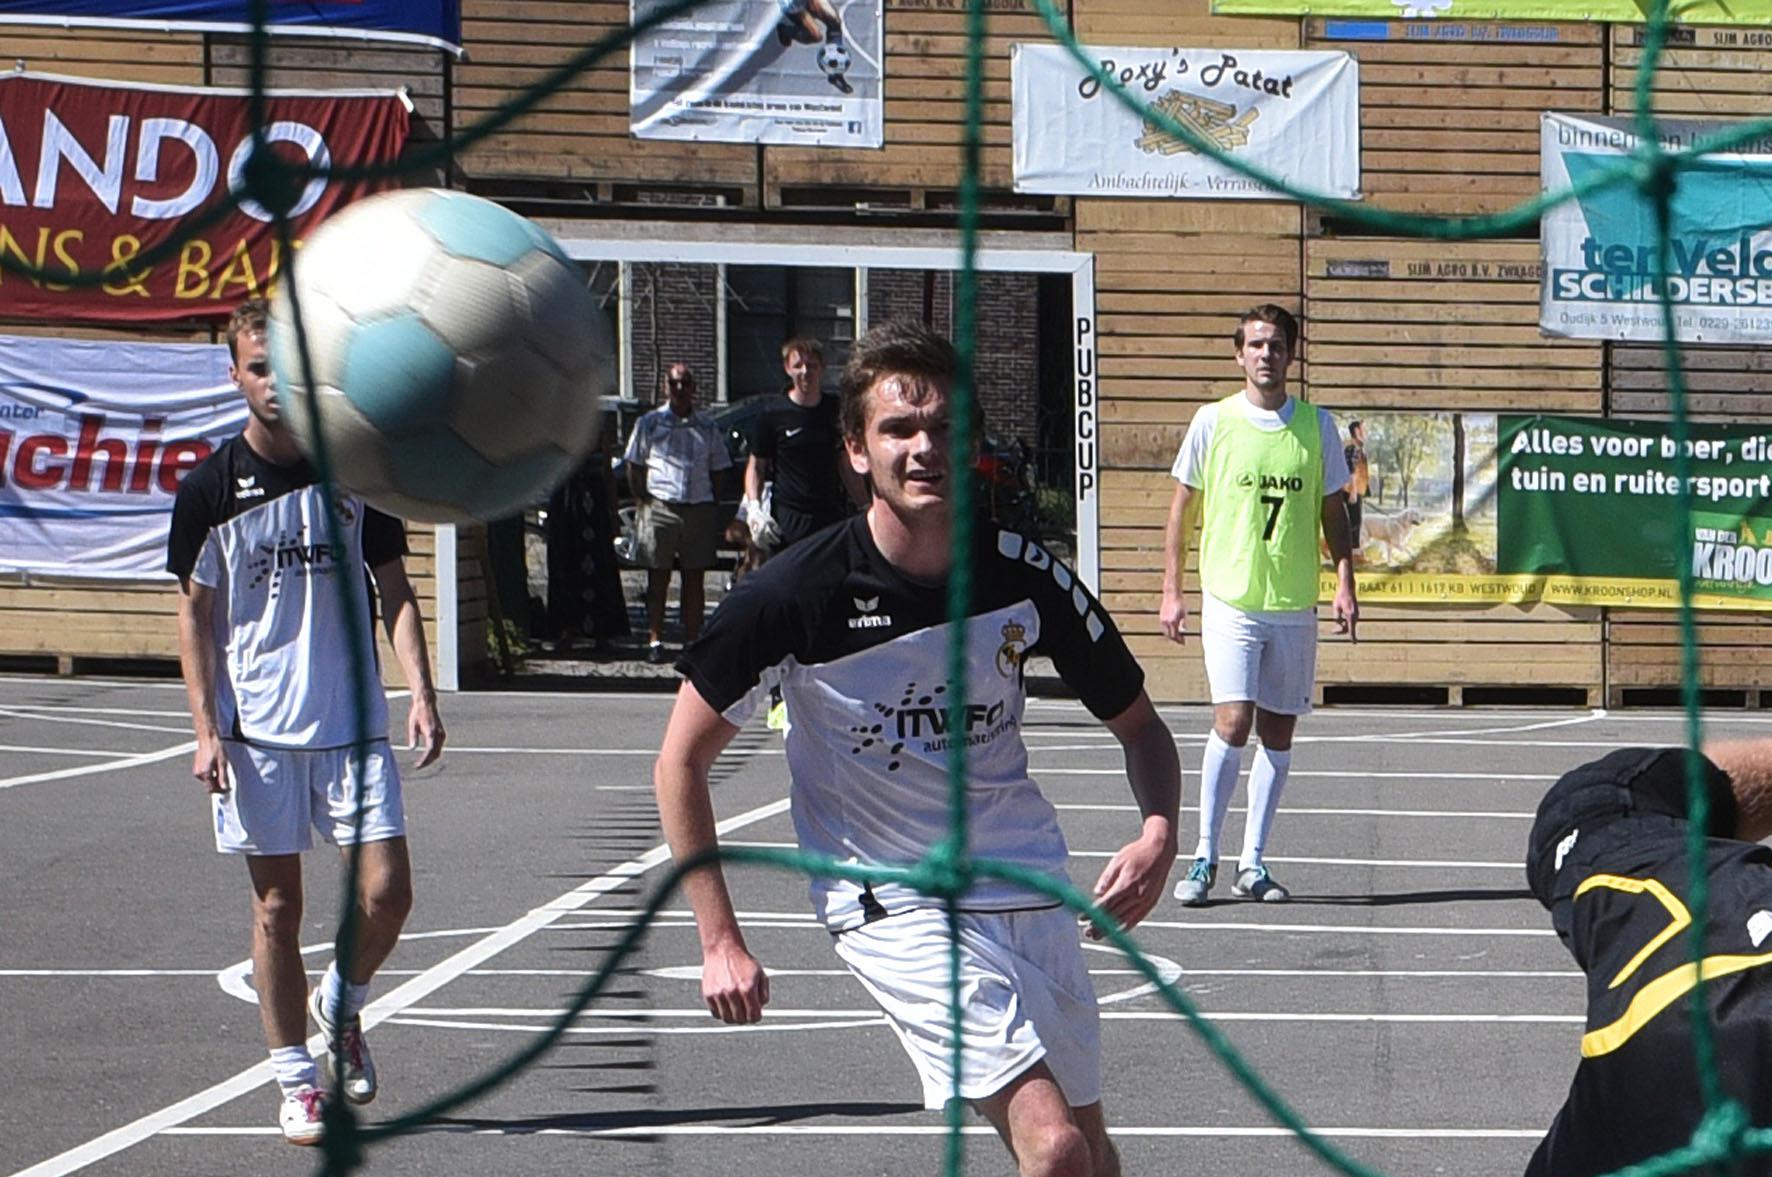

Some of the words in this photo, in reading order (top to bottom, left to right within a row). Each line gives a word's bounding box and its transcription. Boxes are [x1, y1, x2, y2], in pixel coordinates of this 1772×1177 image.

[1713, 32, 1737, 45] SIJM
[1743, 33, 1772, 47] AGRO
[1200, 53, 1293, 98] Patat
[1087, 172, 1189, 193] Ambachtelijk
[1611, 314, 1668, 328] Westwou
[1077, 317, 1094, 501] PUBCUP
[1511, 428, 1584, 455] Alles
[1590, 435, 1654, 457] voor
[1258, 473, 1304, 492] JAKO
[1511, 466, 1566, 492] tuin
[1572, 470, 1607, 493] en
[1260, 494, 1285, 541] 7
[1390, 581, 1403, 593] 61
[1420, 581, 1446, 594] 1617
[1449, 582, 1465, 594] KB
[1469, 582, 1537, 596] WESTWOUD
[1550, 584, 1674, 599] WWW.KROONSHOP.NL
[848, 614, 892, 628] erima
